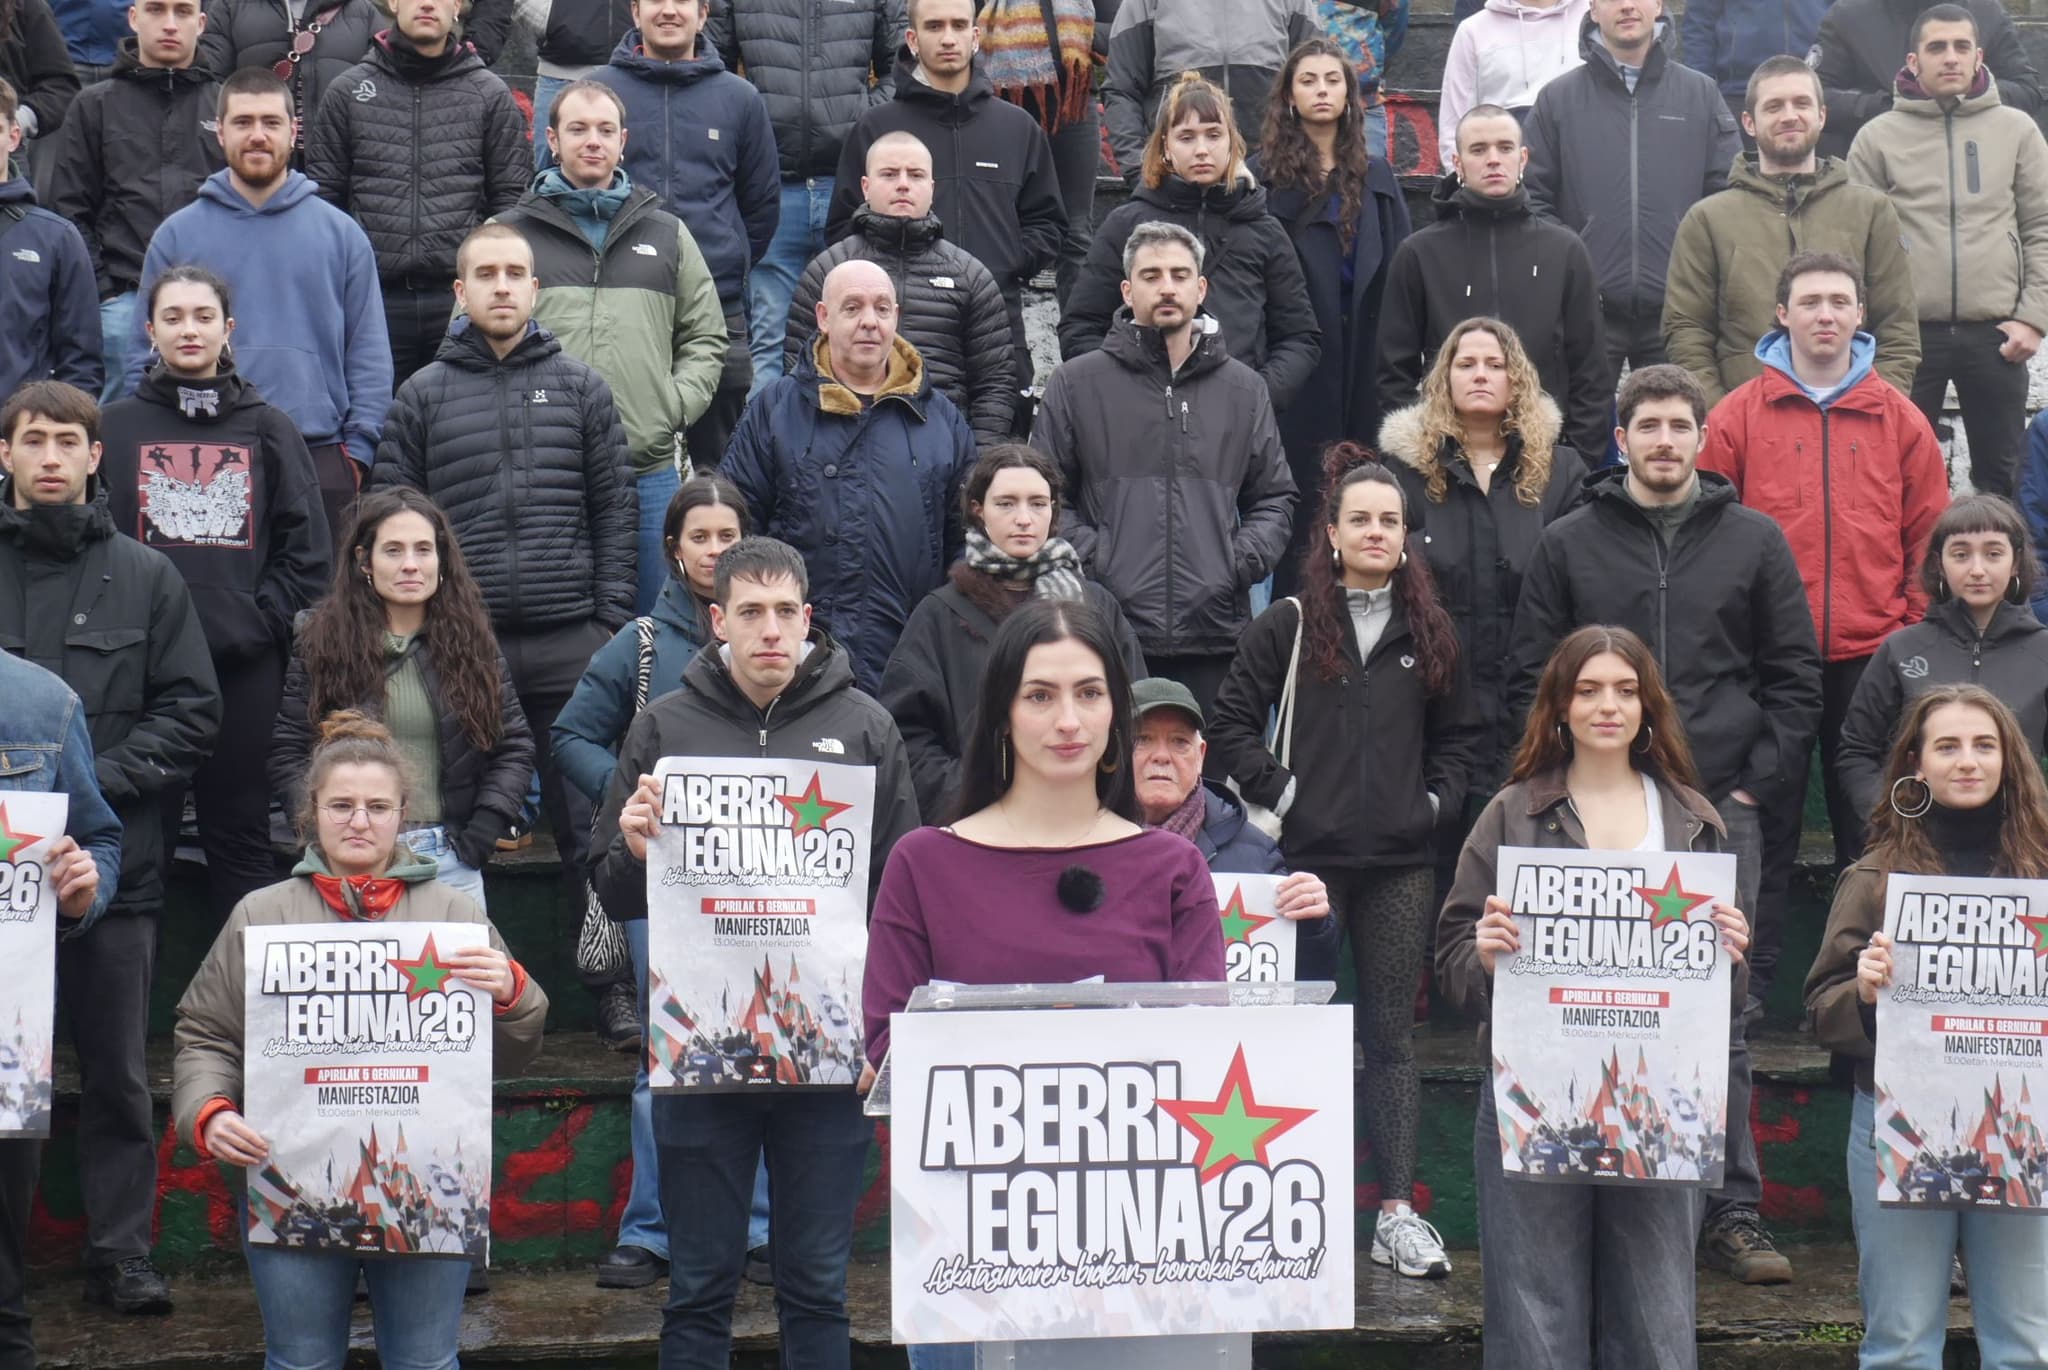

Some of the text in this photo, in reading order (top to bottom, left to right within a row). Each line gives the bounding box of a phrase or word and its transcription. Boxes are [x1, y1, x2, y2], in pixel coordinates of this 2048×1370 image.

[660, 774, 787, 827] ABERRI
[683, 825, 854, 877] EGUNA 26
[714, 900, 808, 913] APIRILAK 5 GERNIKAN
[1510, 864, 1646, 919] ABERRI
[714, 917, 810, 936] MANIFESTAZIOA
[1533, 916, 1717, 970] EGUNA 26
[1895, 891, 2030, 947] ABERRI
[261, 939, 401, 995] ABERRI
[1916, 943, 2040, 997] EGUNA
[286, 990, 475, 1044] EGUNA 26
[1562, 989, 1660, 1006] APIRILAK 5 GERNIKAN
[1562, 1007, 1661, 1029] MANIFESTAZIOA
[1944, 1017, 2042, 1034] APIRILAK 5 GERNIKAN
[1944, 1034, 2043, 1057] MANIFESTAZIOA
[318, 1067, 418, 1082] APIRILAK 5 GERNIKAN
[318, 1085, 420, 1105] MANIFESTAZIOA
[920, 1060, 1183, 1171] ABERRI
[966, 1158, 1326, 1269] EGUNA 26
[924, 1253, 1070, 1295] Askatasunaren
[1152, 1246, 1245, 1284] borrokak
[1247, 1244, 1327, 1284] darrai!
